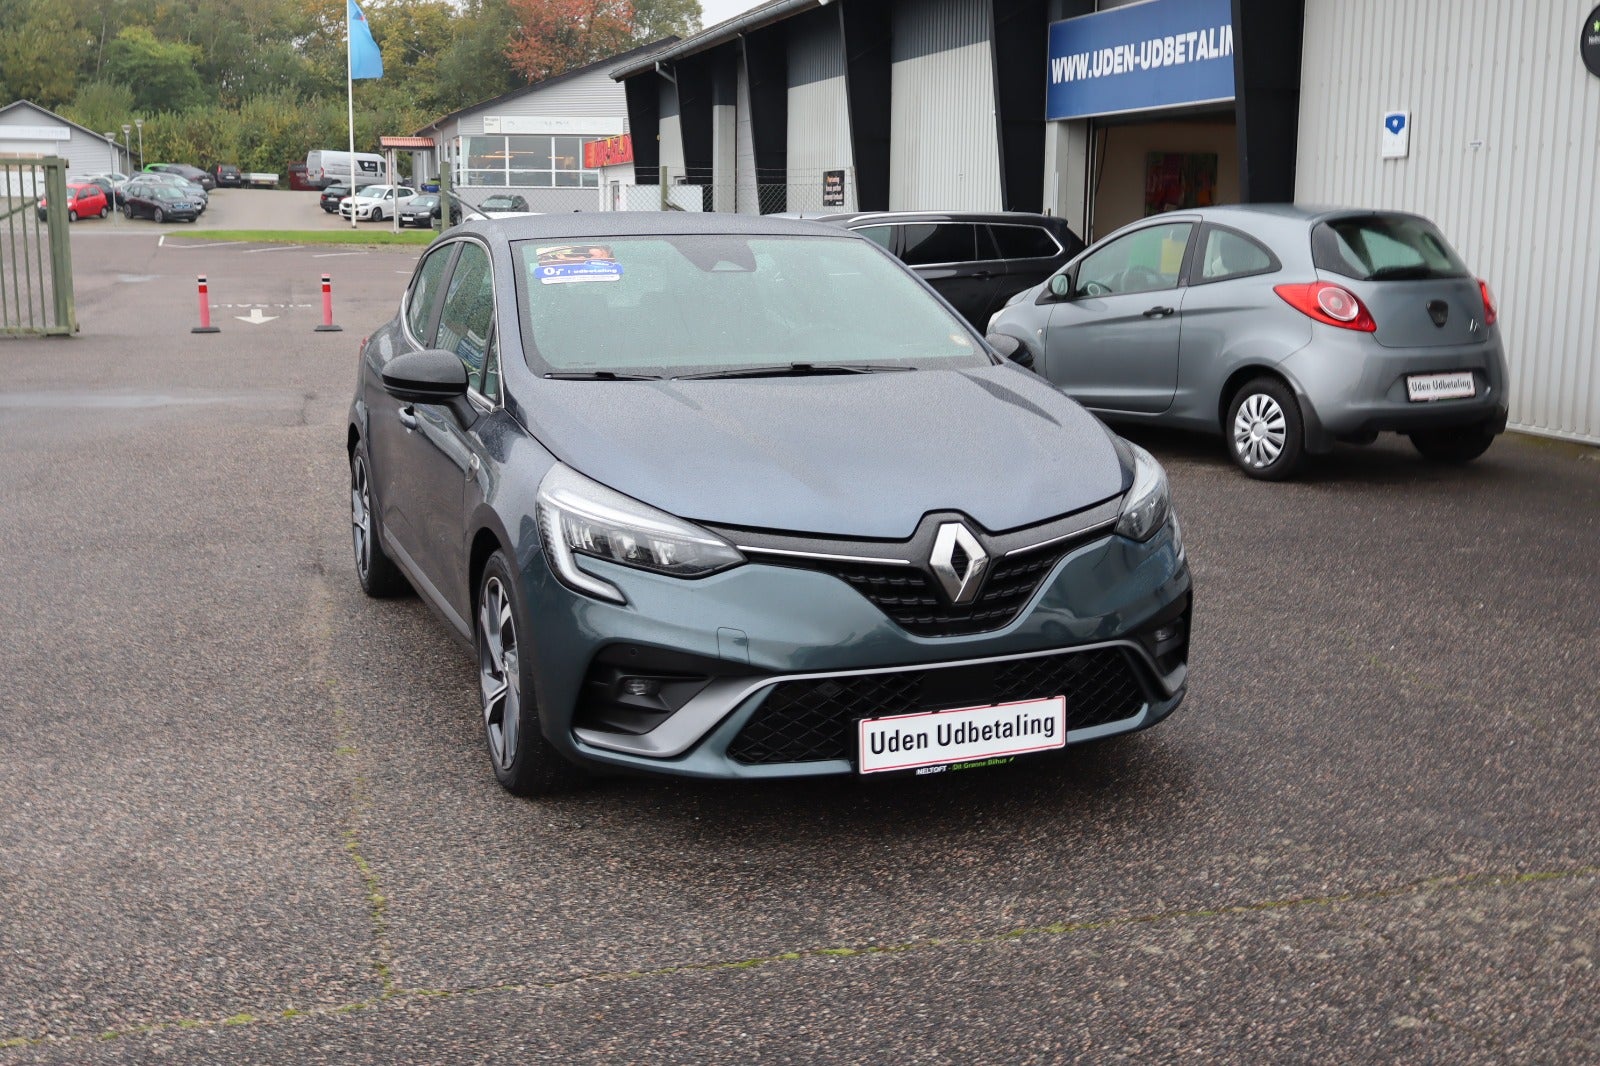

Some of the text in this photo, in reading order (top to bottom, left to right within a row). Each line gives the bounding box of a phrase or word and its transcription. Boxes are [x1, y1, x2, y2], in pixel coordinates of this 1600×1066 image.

[870, 714, 1055, 755] Uden Udbetaling
[916, 765, 947, 776] NELTOFT
